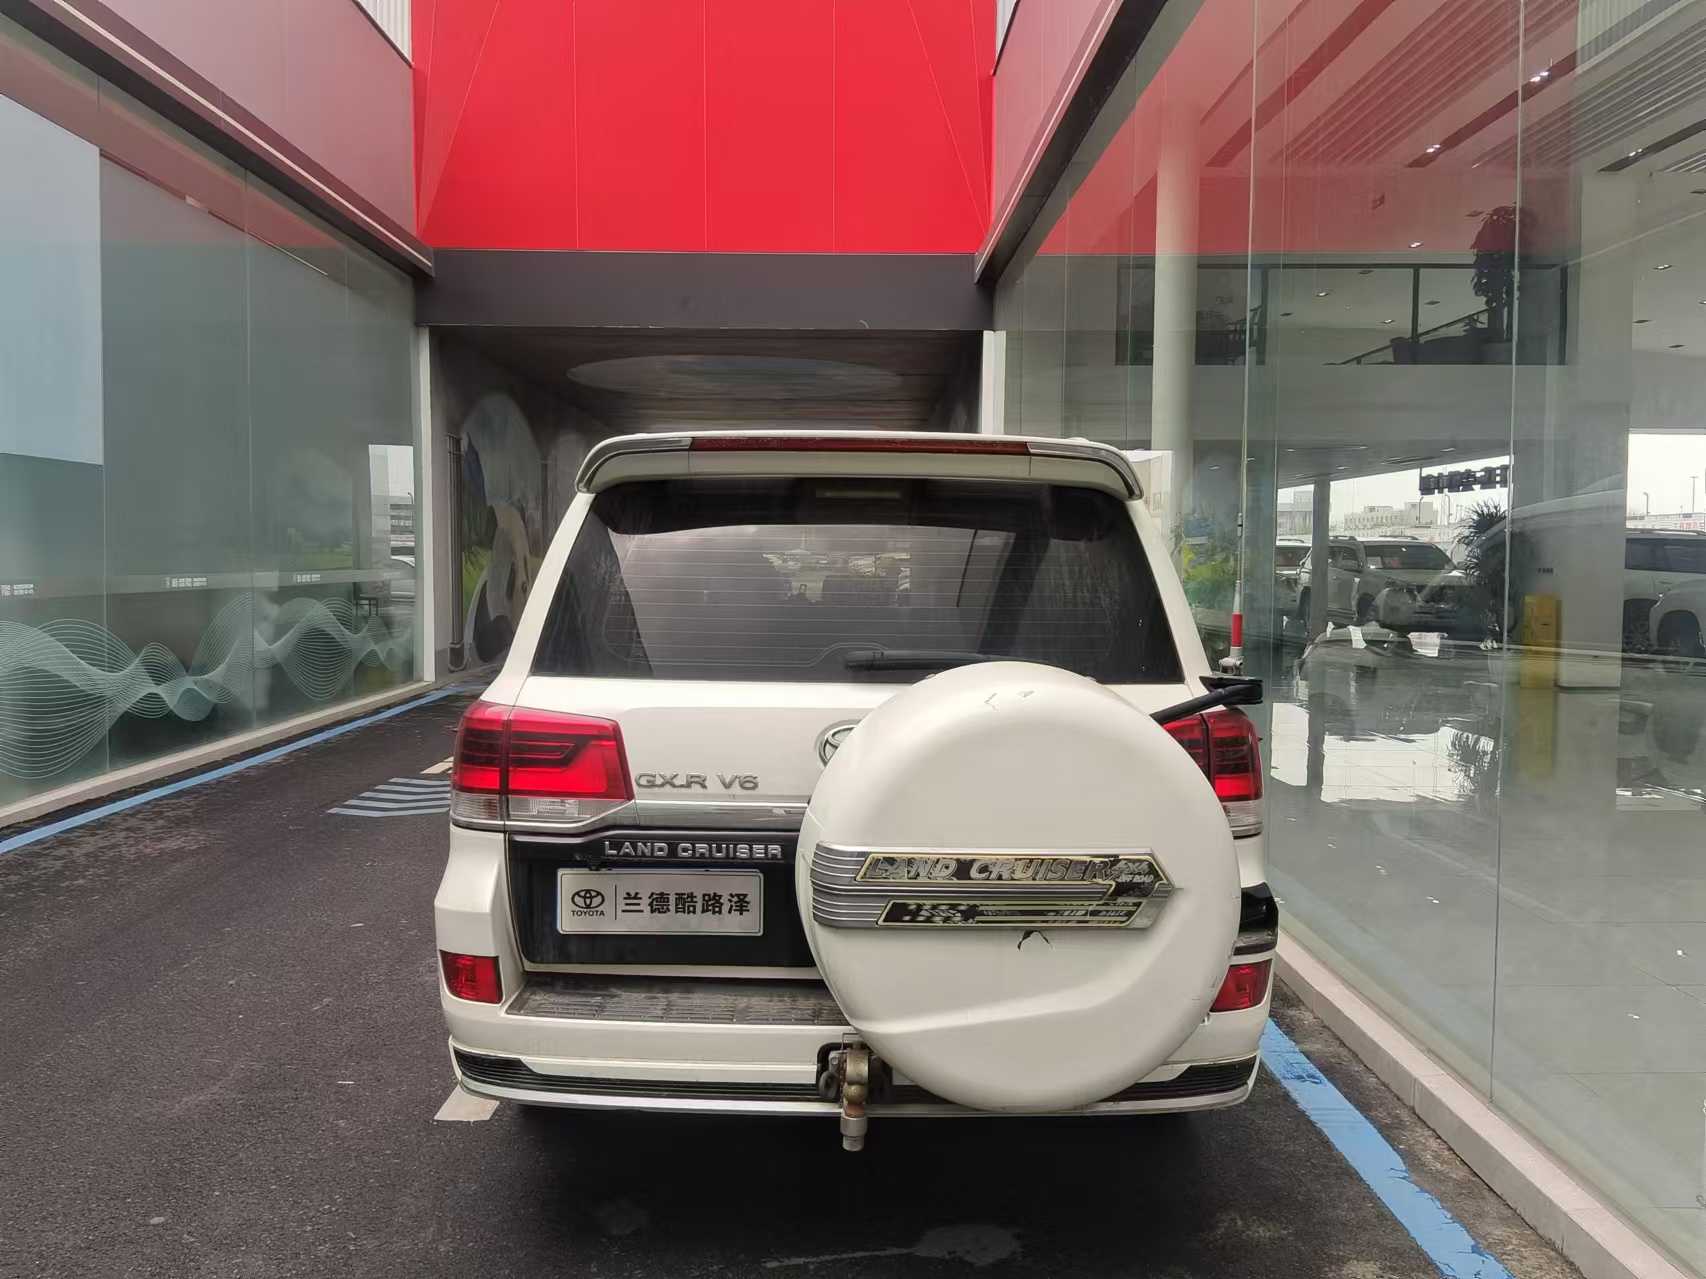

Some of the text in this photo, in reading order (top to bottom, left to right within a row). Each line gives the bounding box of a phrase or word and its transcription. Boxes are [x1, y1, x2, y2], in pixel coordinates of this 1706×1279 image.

[717, 774, 758, 790] V6
[604, 841, 782, 859] LAND CRUISER
[969, 858, 1108, 881] CRUISER
[621, 891, 751, 916] 兰德酷路泽
[571, 909, 605, 917] TOYOTA
